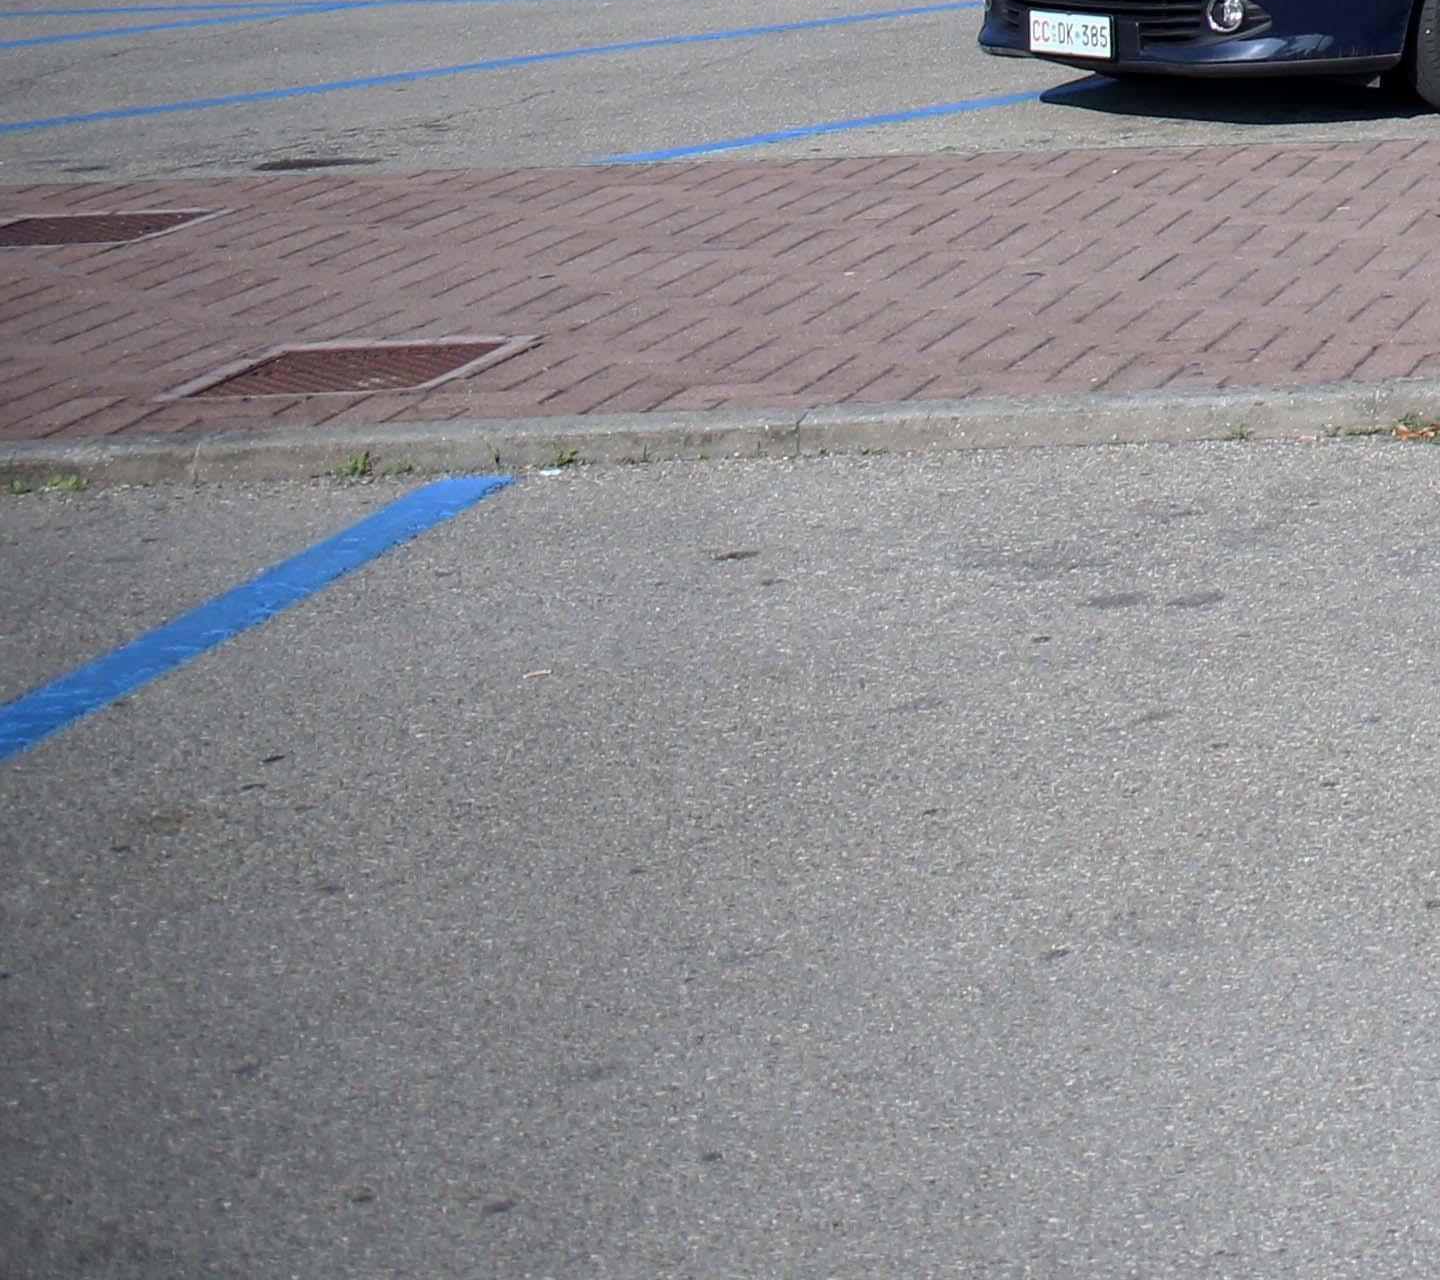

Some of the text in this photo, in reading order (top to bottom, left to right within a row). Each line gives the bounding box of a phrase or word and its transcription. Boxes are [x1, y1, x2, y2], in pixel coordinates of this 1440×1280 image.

[1032, 19, 1108, 48] CC DK 385
